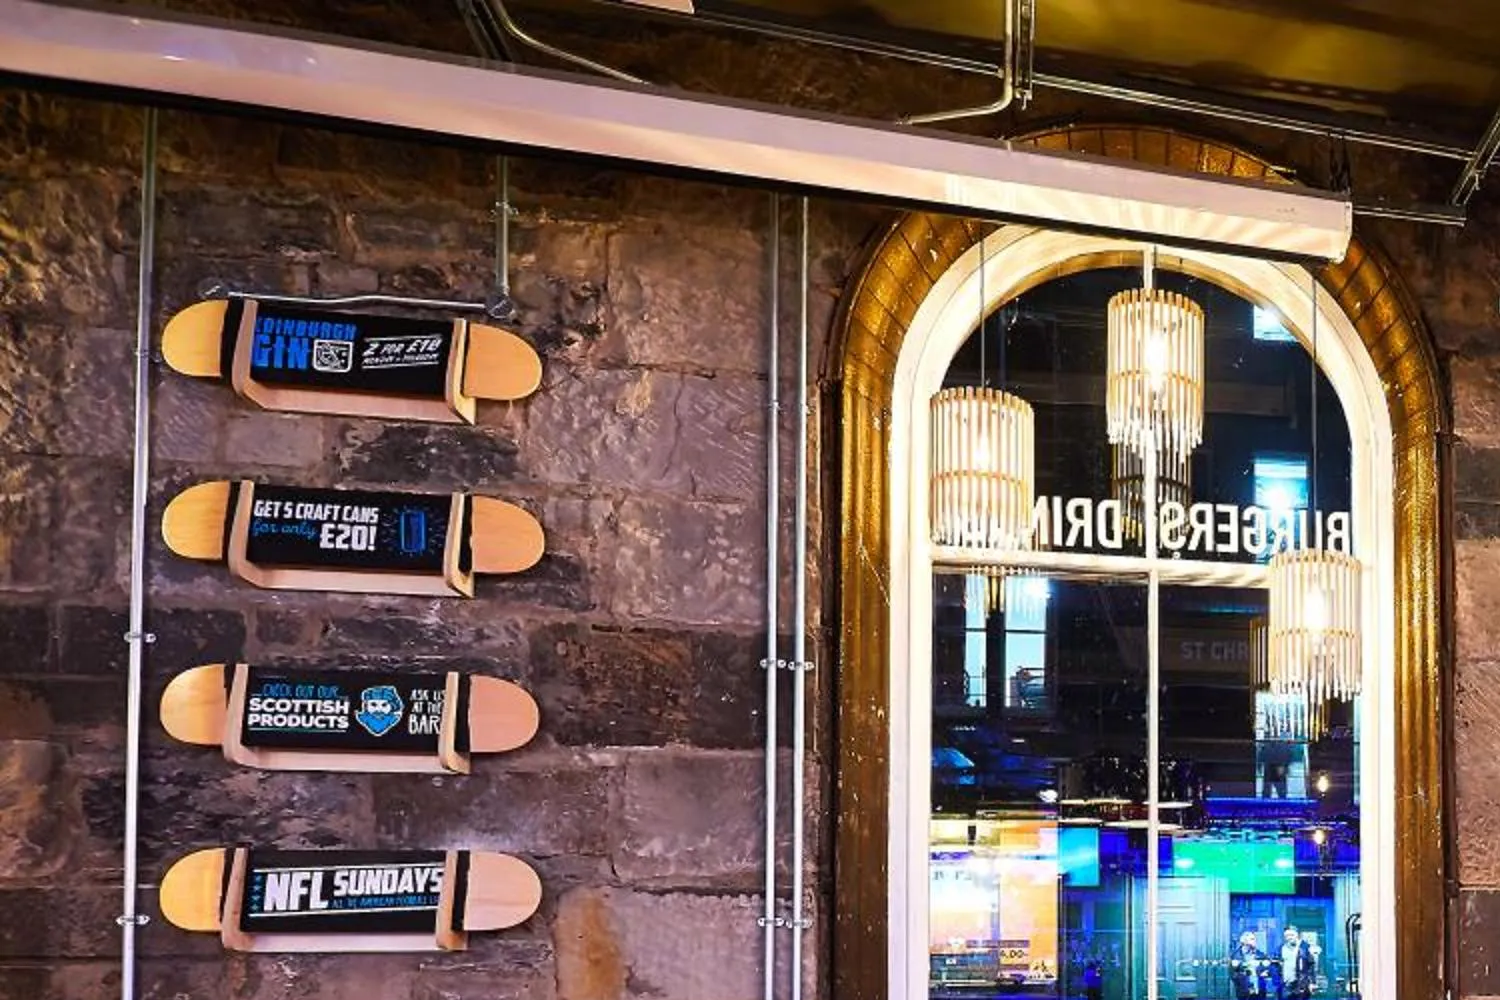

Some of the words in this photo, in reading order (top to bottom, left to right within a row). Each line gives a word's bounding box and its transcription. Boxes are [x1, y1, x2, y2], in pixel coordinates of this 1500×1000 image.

[253, 334, 309, 370] GIN
[253, 500, 281, 518] GET
[283, 502, 293, 519] 5
[295, 503, 341, 521] CRAFT
[342, 505, 379, 523] CANS
[320, 523, 377, 551] £20!
[249, 697, 350, 714] SCOTTISH
[410, 689, 429, 701] ASK
[411, 701, 423, 713] AT
[247, 713, 349, 729] PRODUCTS
[409, 713, 441, 735] BAR
[264, 871, 329, 911] NFL
[333, 867, 444, 897] SUNDAYS
